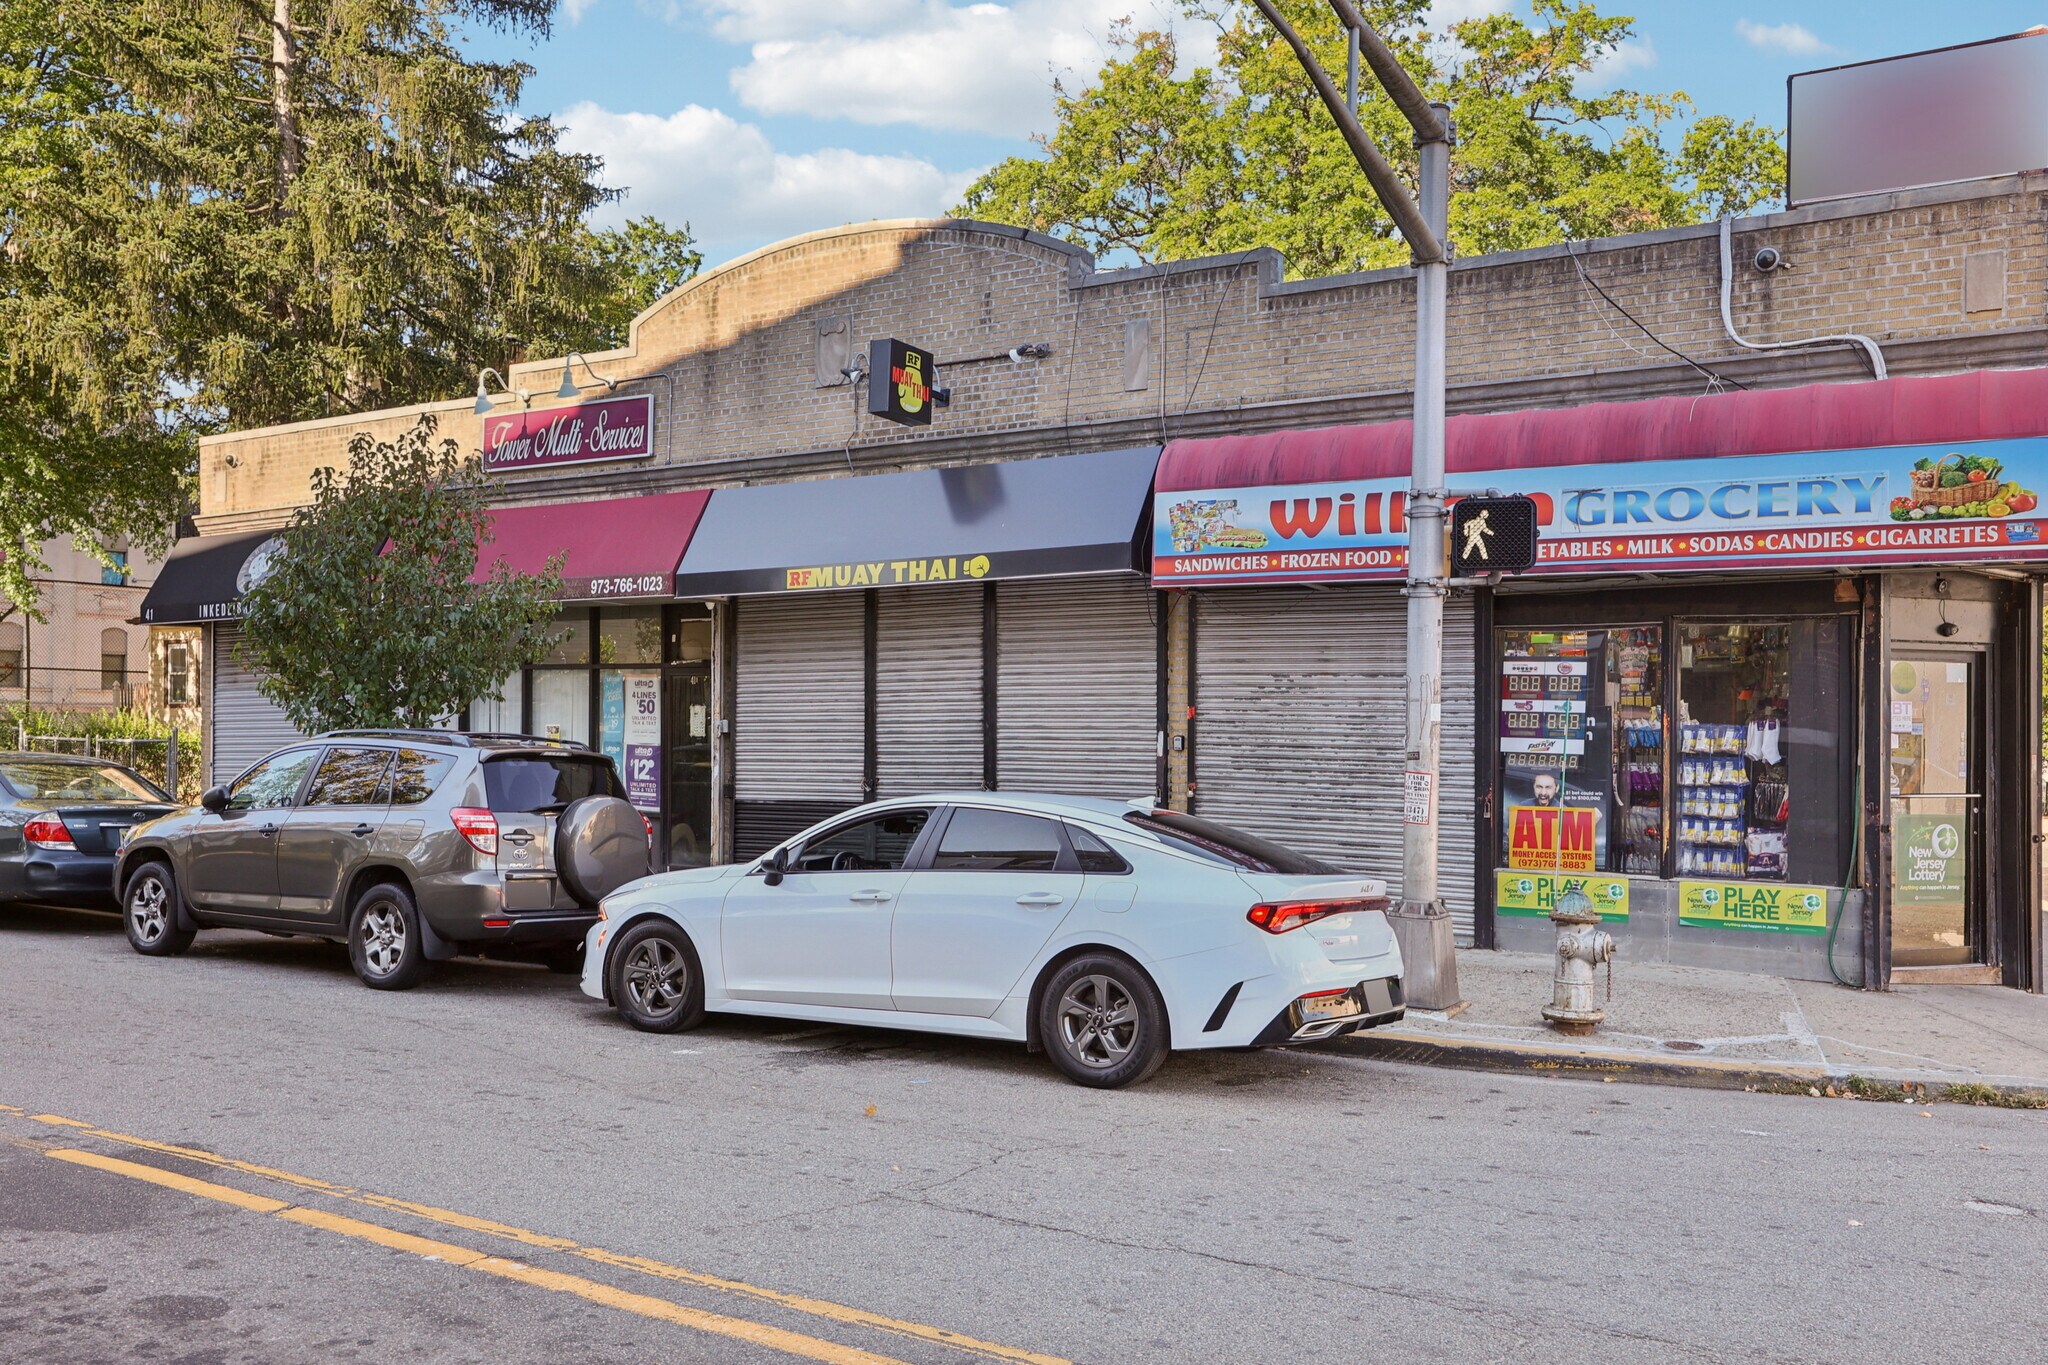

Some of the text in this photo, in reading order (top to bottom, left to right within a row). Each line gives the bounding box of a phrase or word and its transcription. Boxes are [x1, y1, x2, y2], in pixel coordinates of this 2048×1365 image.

[907, 354, 920, 366] RF
[892, 366, 913, 388] MUAY
[912, 382, 929, 402] THAI
[489, 421, 531, 462] Tower
[534, 414, 584, 458] Multi
[1565, 476, 1888, 526] GROCERY
[1174, 556, 1268, 572] SANDWICHES
[1281, 553, 1340, 568] FROZEN
[1345, 550, 1392, 566] FOOD
[1538, 540, 1612, 558] ETABLES
[1627, 538, 1674, 555] MILK
[1690, 534, 1754, 552] SODAS
[1766, 530, 1853, 550] CANDIES
[1865, 525, 1998, 546] CIGARRETES
[813, 563, 884, 588] MUAY
[891, 558, 956, 582] THAI
[590, 576, 663, 594] 973-766-1023
[145, 609, 154, 620] 41
[1893, 703, 1911, 714] BT
[1513, 810, 1592, 851] ATM
[1909, 846, 1932, 858] New
[1914, 858, 1946, 871] Jersey
[1909, 869, 1946, 882] Lottery
[1725, 887, 1781, 904] PLAY
[1725, 903, 1779, 920] HERE
